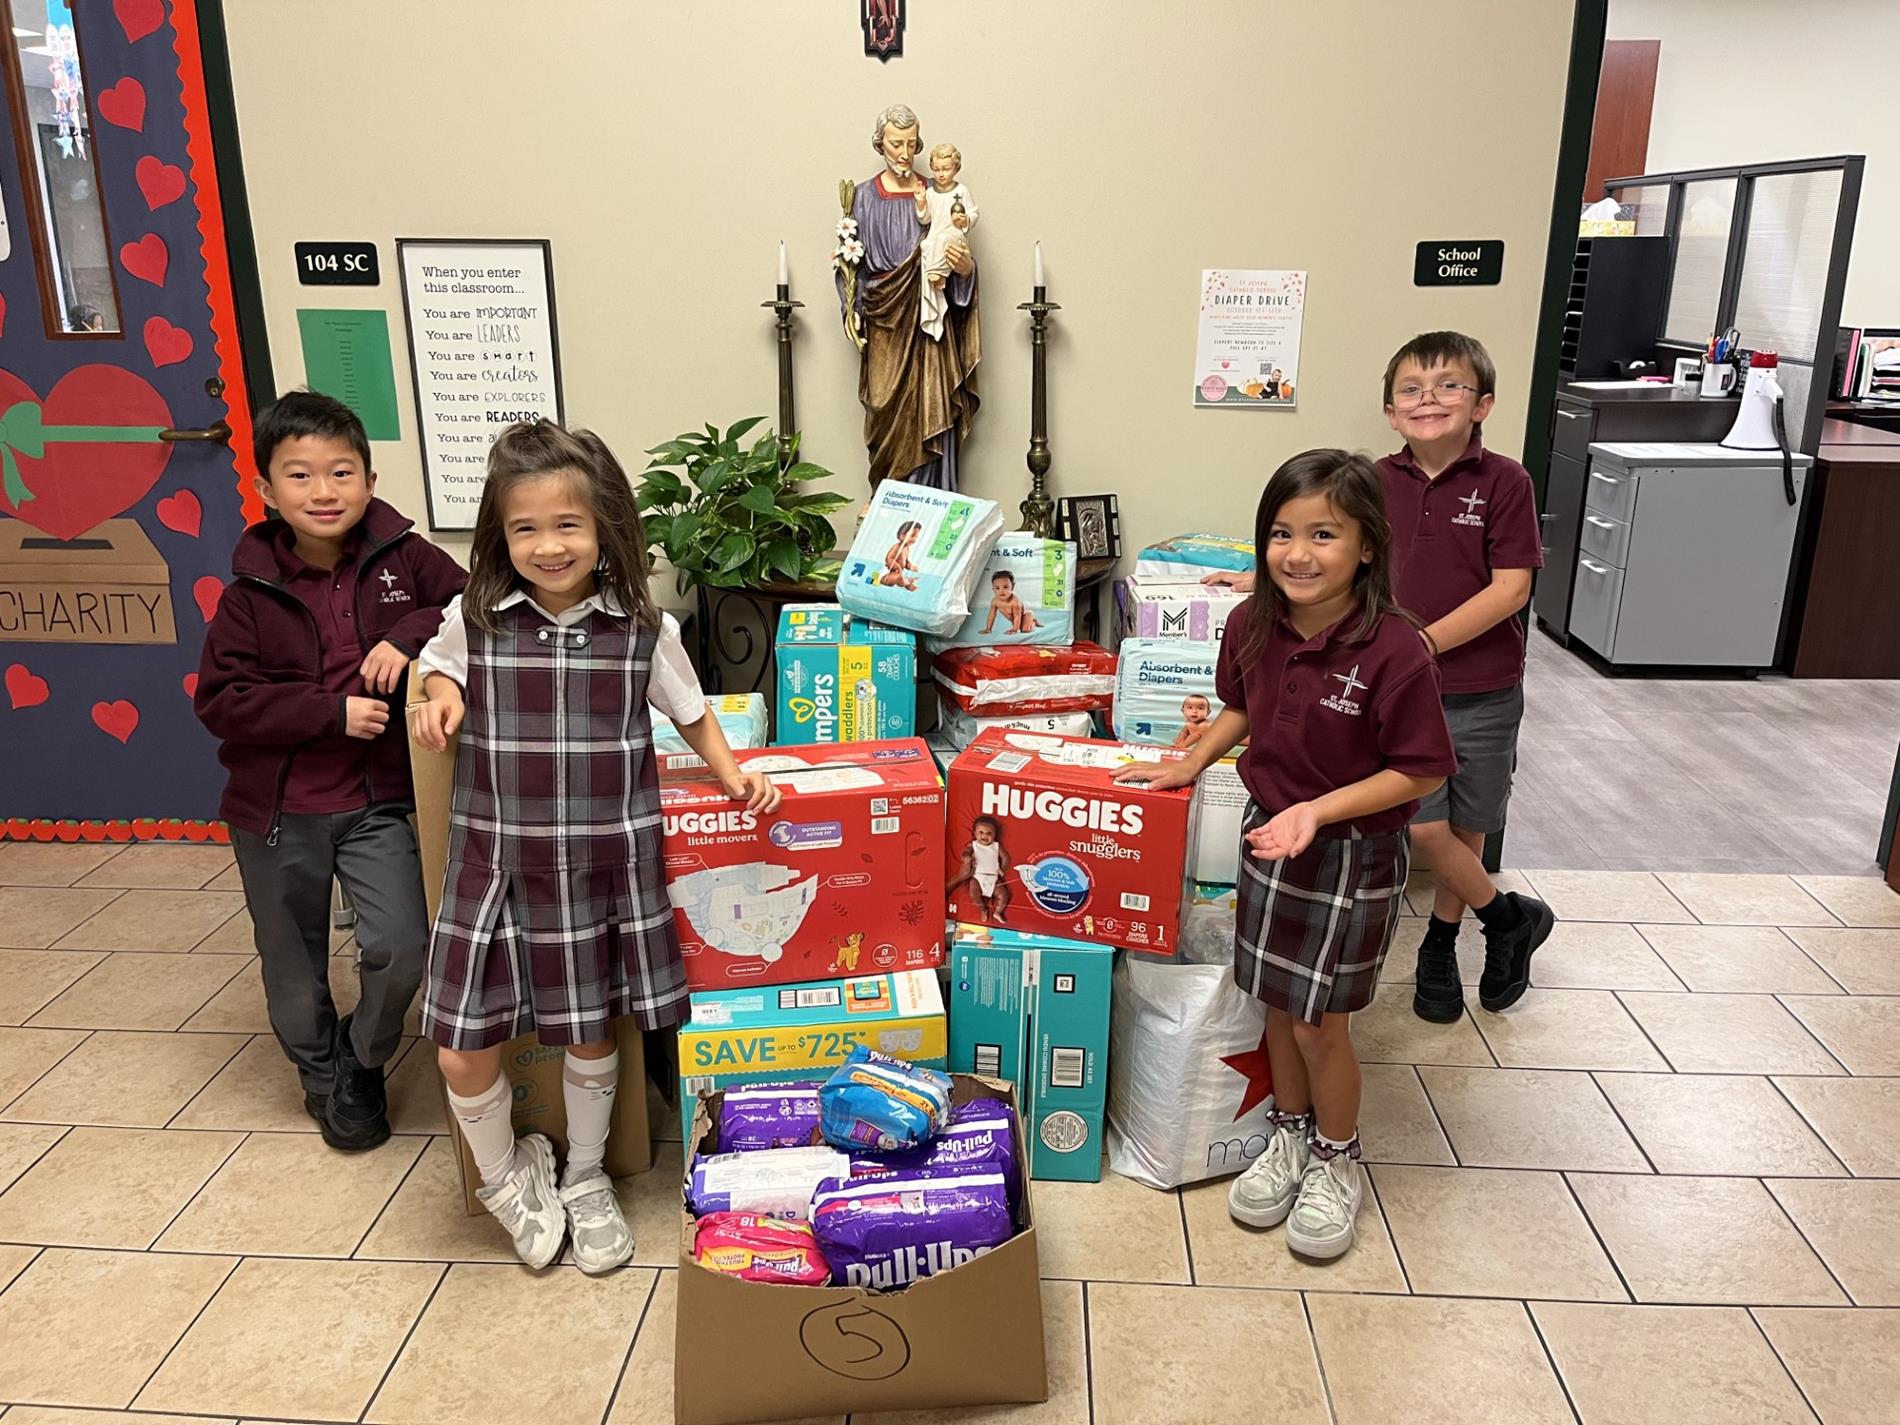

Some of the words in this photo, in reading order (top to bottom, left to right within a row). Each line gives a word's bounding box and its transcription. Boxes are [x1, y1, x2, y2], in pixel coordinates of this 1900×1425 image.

[1438, 247, 1481, 261] School
[304, 254, 338, 272] 104
[344, 254, 370, 272] SC
[422, 266, 458, 278] When
[461, 268, 484, 282] you
[487, 268, 521, 278] enter
[1438, 264, 1478, 277] Office
[424, 282, 448, 293] this
[451, 282, 525, 294] classroom...
[1214, 295, 1252, 305] DIAPER
[1258, 296, 1290, 306] DRIVE
[423, 309, 446, 319] You
[450, 310, 470, 319] are
[476, 307, 538, 320] IMPORTANT
[426, 330, 449, 341] You
[452, 332, 473, 341] are
[478, 324, 521, 343] LEADERS
[428, 351, 451, 361] You
[430, 371, 454, 381] You
[482, 365, 538, 383] creators
[432, 392, 456, 402] You
[458, 394, 479, 402] are
[484, 392, 546, 402] EXPLORERS
[434, 412, 458, 423] You
[486, 411, 540, 423] READERS
[436, 434, 460, 443] You
[439, 454, 463, 464] You
[466, 456, 485, 464] are
[441, 474, 464, 484] You
[467, 476, 486, 484] are
[443, 494, 466, 504] You
[469, 496, 482, 504] ar
[882, 497, 910, 508] Diapers
[885, 490, 924, 504] Absorbent
[1002, 548, 1010, 557] &
[1012, 548, 1033, 557] Soft
[1055, 550, 1062, 560] 3
[0, 591, 161, 634] CHARITY
[851, 662, 862, 670] 5
[878, 661, 887, 673] 58
[1139, 660, 1202, 675] Absorbent
[1204, 666, 1213, 675] &
[1139, 672, 1183, 684] Diapers
[814, 674, 838, 743] mpers
[1320, 698, 1344, 712] CATHOLIC
[842, 691, 854, 742] waddlers
[1048, 719, 1055, 730] 5
[982, 782, 1144, 836] HUGGIES
[662, 810, 757, 836] UGGIES
[688, 836, 715, 846] little
[717, 833, 758, 844] movers
[1091, 833, 1115, 846] little
[1069, 840, 1141, 860] snugglers
[1048, 869, 1070, 880] 100%
[1130, 922, 1146, 933] 96
[1156, 925, 1164, 941] 1
[906, 949, 923, 959] 116
[929, 942, 940, 957] 4
[695, 1036, 776, 1067] SAVE
[798, 1032, 858, 1059] $725
[1206, 1133, 1268, 1168] ma
[740, 1216, 755, 1227] 18
[834, 1308, 884, 1364] 5
